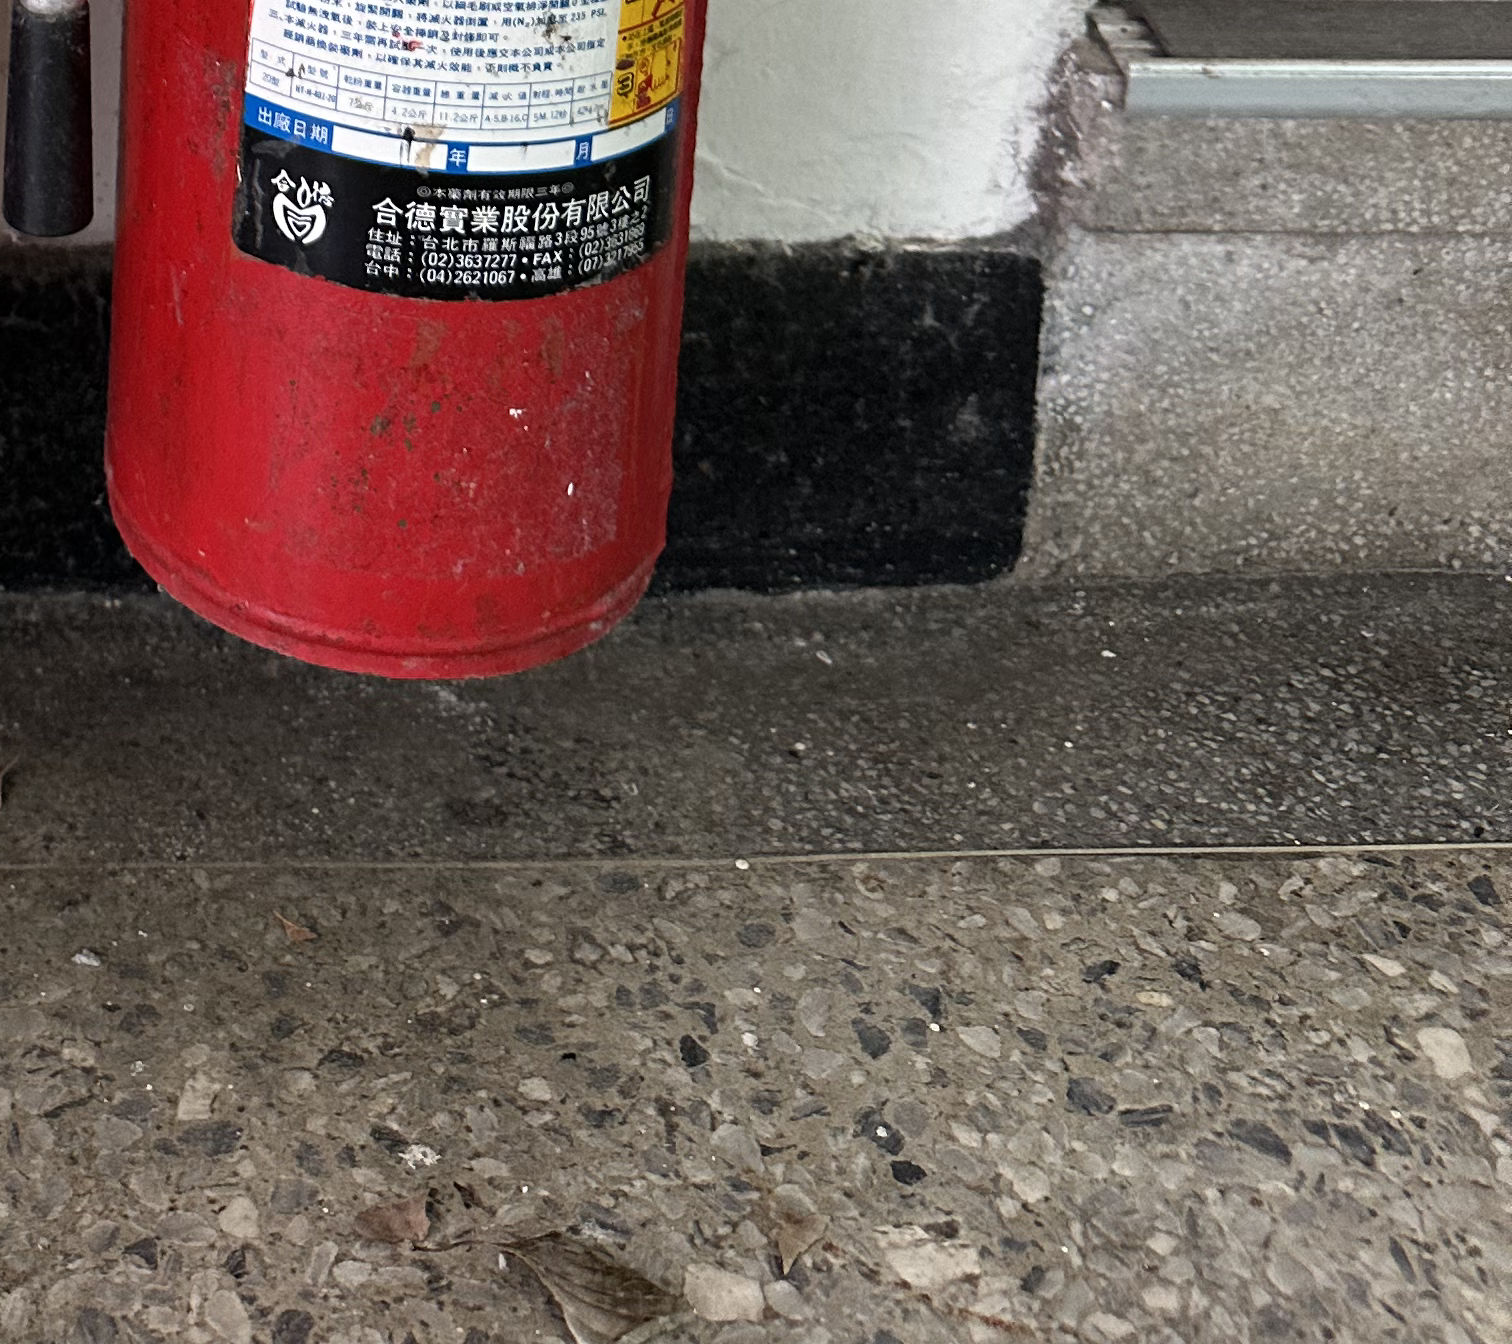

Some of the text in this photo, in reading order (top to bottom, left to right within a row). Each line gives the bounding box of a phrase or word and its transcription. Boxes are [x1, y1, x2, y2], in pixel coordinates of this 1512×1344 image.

[256, 105, 329, 145] 出廠日期
[448, 147, 467, 167] 年
[575, 141, 590, 161] 月
[371, 174, 652, 233] 合德實業股份有限公司
